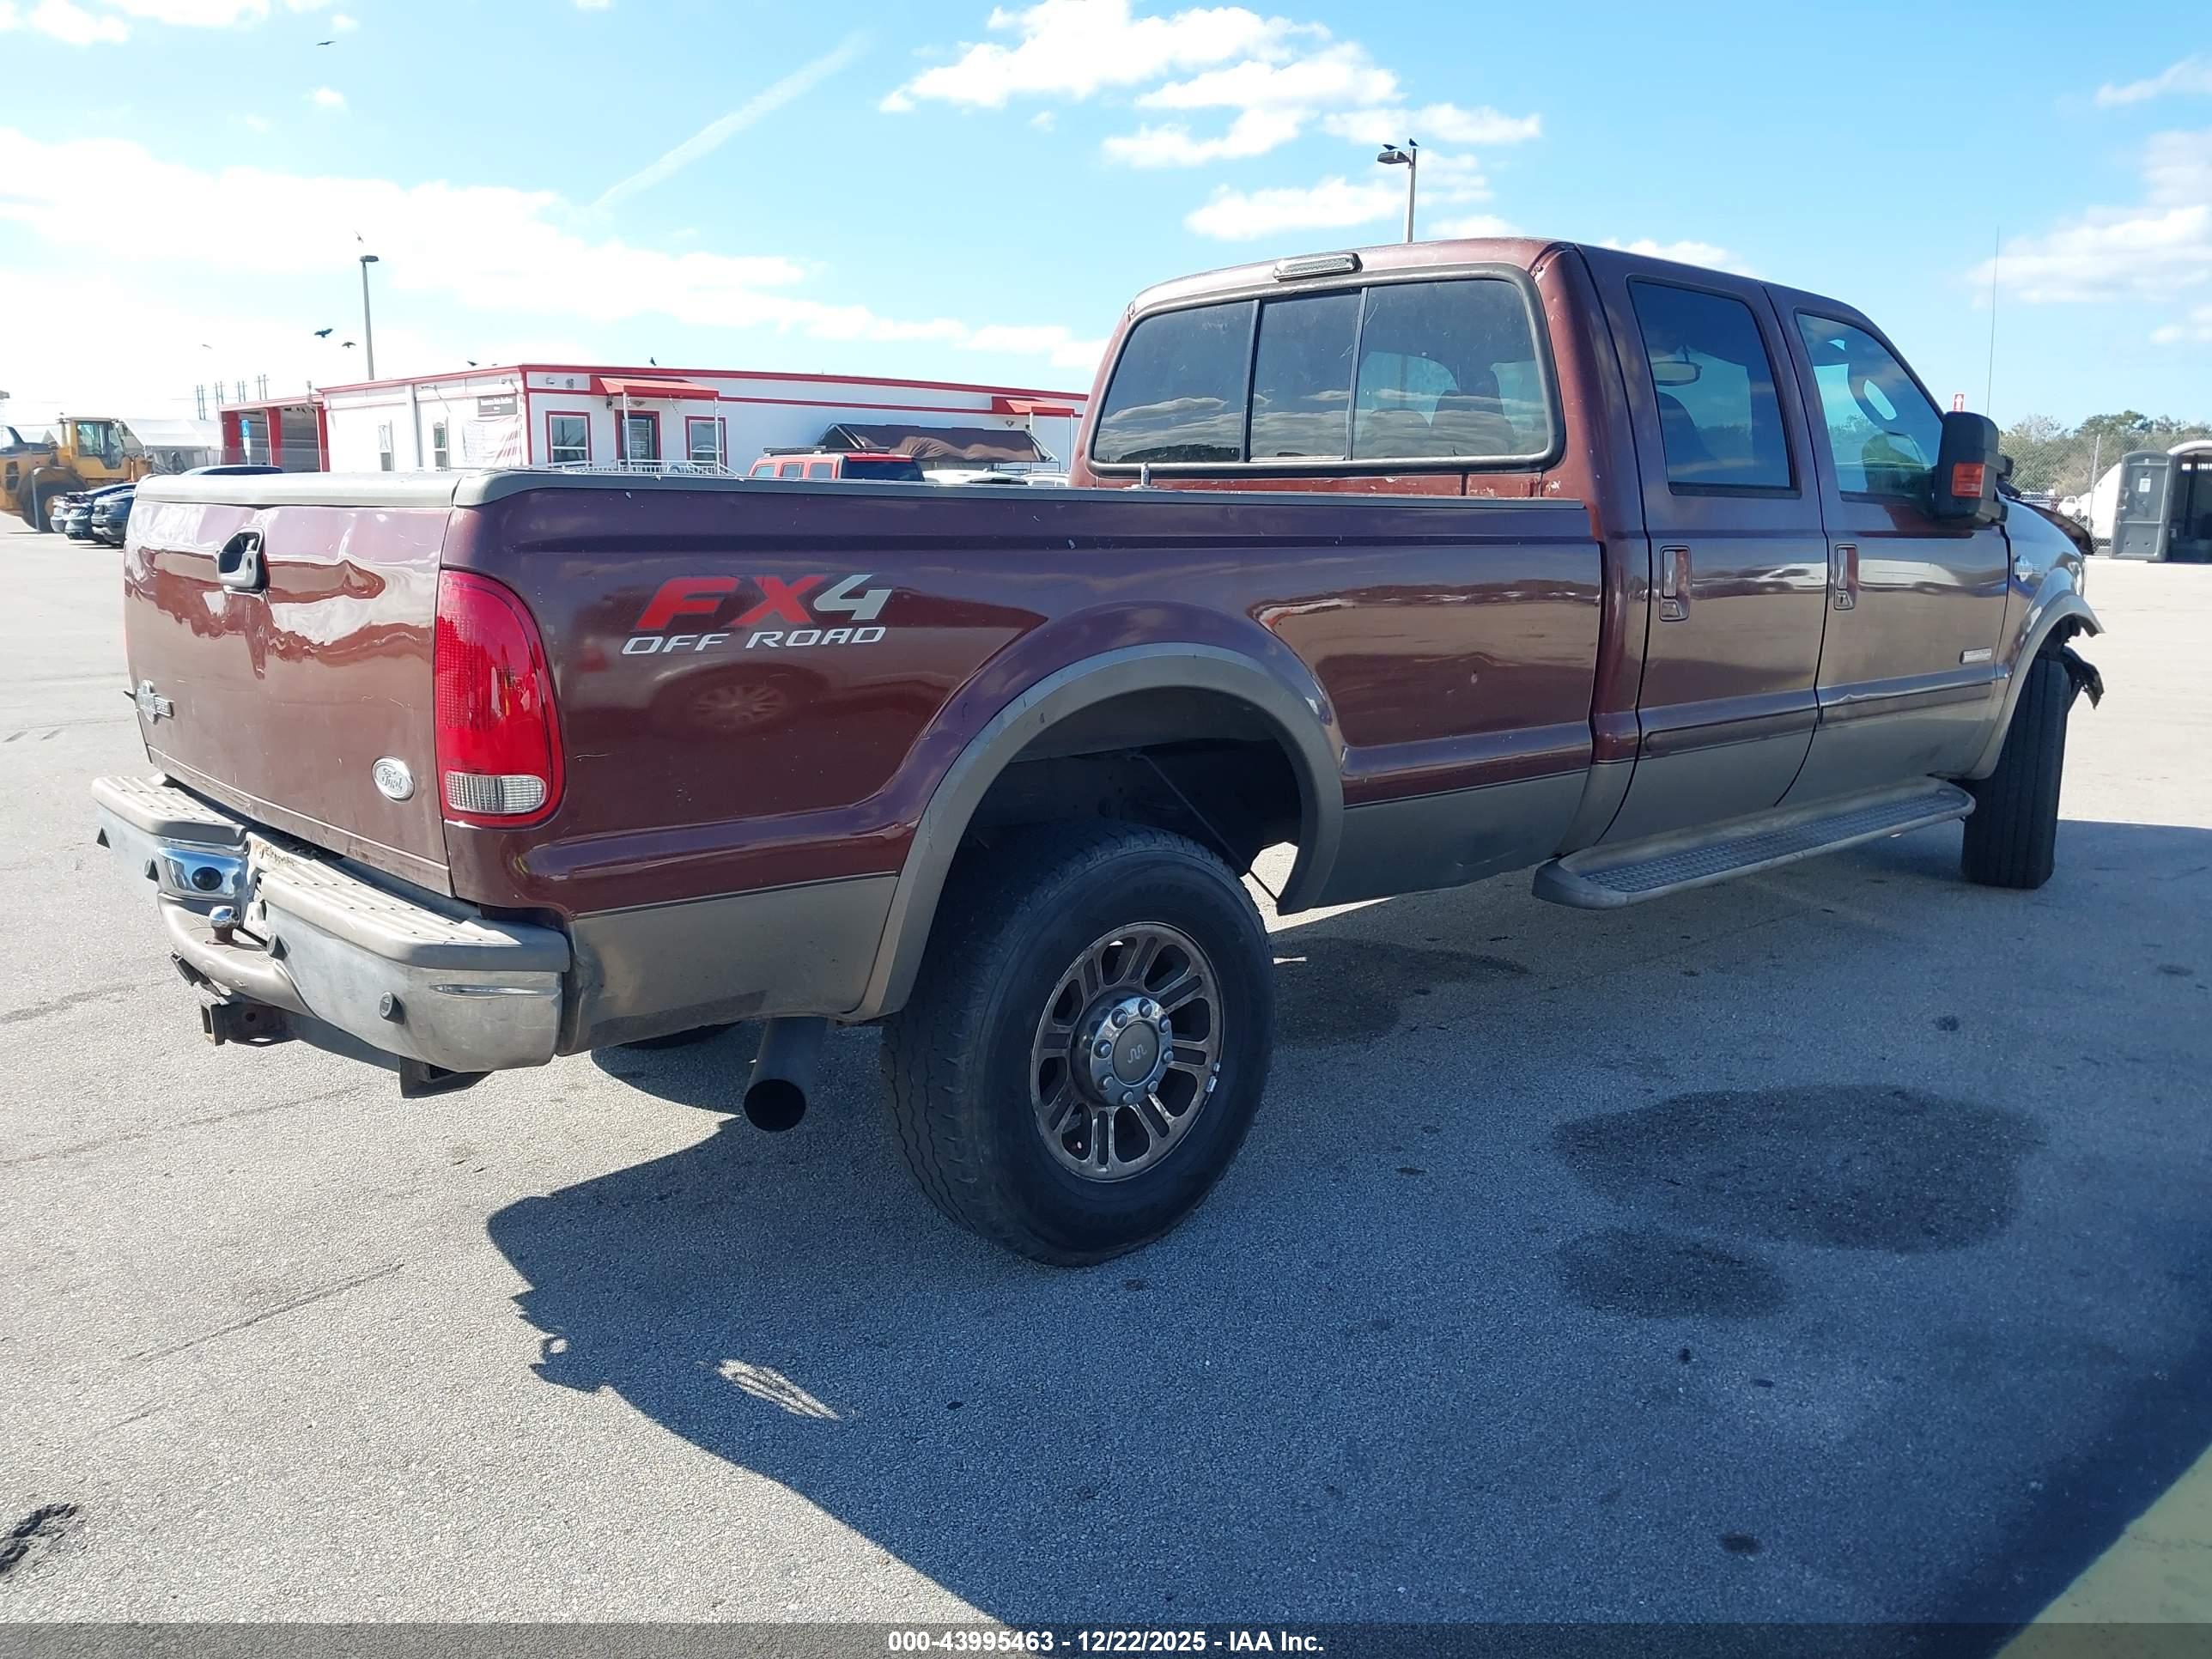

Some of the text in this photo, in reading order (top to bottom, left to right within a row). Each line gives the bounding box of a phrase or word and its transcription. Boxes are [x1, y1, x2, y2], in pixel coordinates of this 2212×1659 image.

[635, 574, 893, 630] FX4
[622, 627, 887, 655] OFF ROAD
